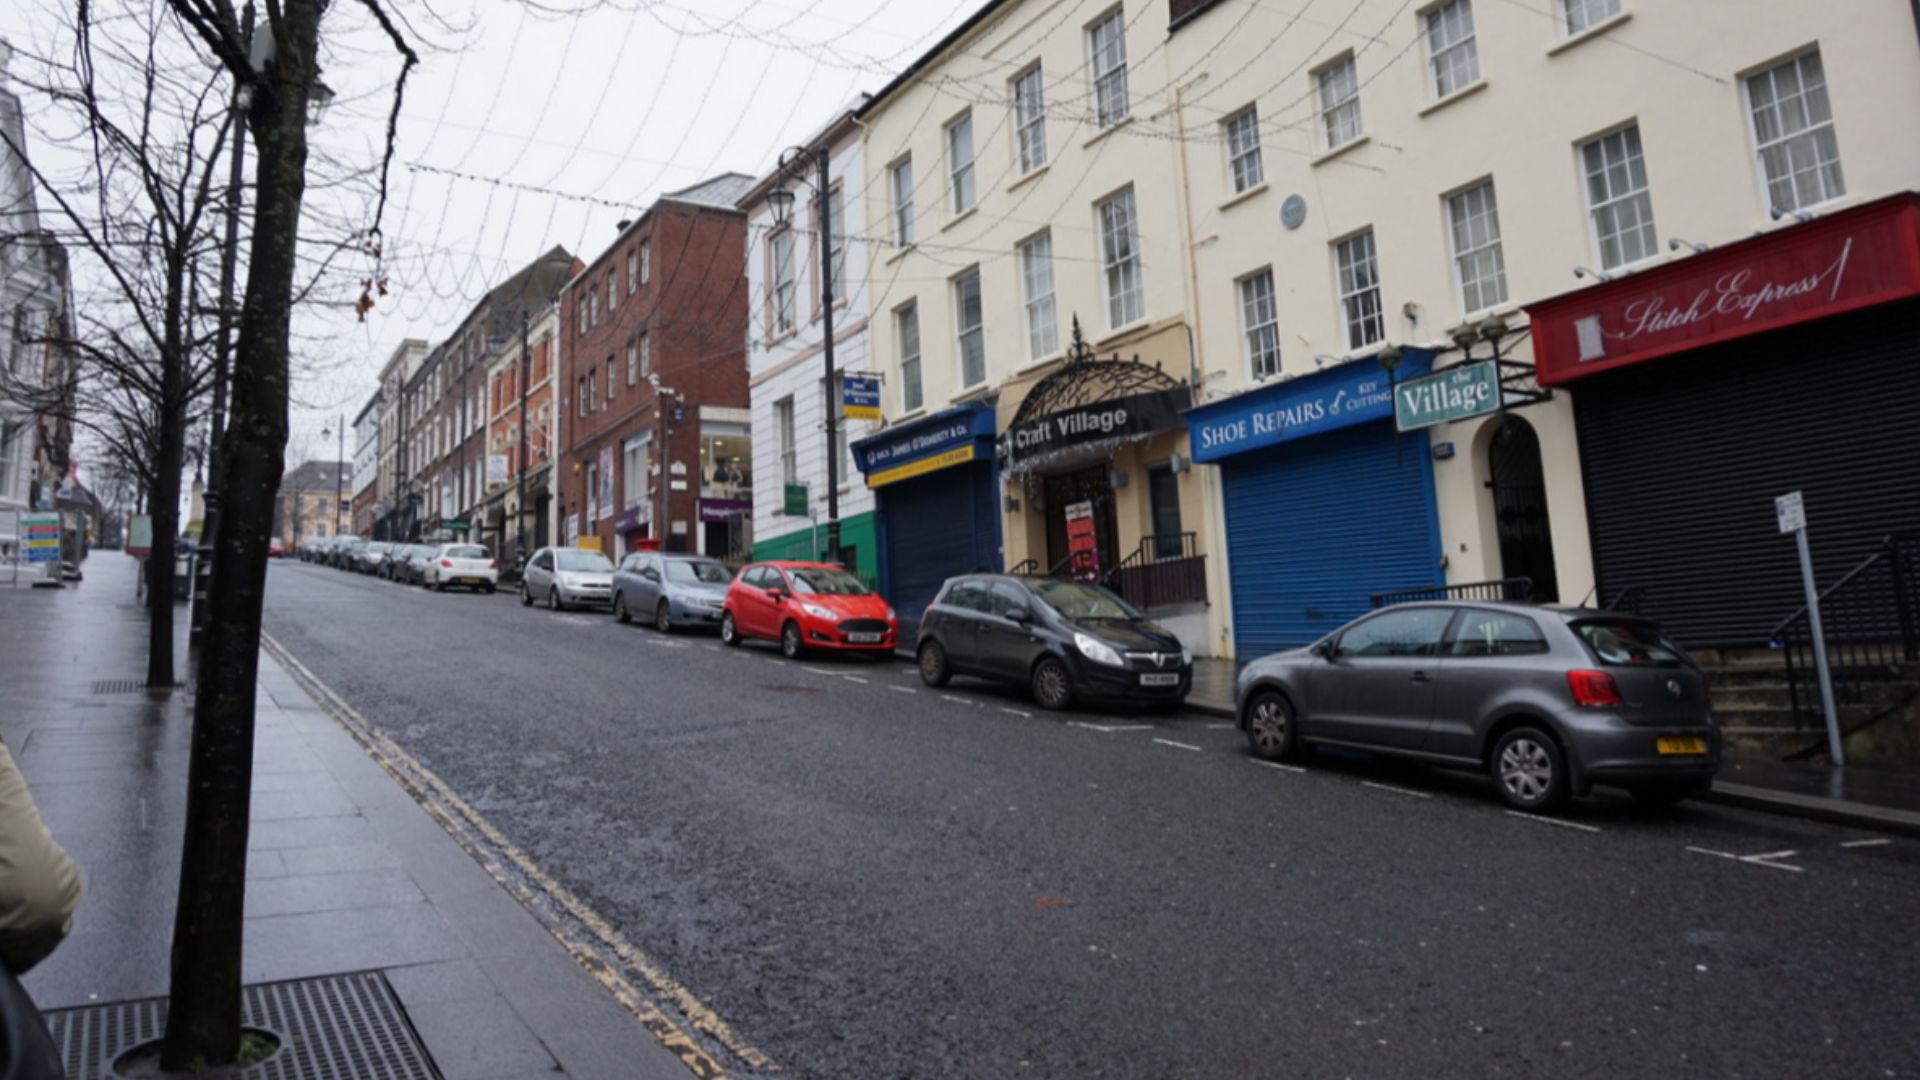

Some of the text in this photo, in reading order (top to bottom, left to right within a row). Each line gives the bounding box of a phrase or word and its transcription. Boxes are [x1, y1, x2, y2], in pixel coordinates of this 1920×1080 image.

[1619, 269, 1819, 338] Stitch Express
[1346, 391, 1392, 411] CUTTING
[1358, 382, 1378, 395] KEY
[1403, 381, 1489, 416] Village
[1016, 408, 1127, 448] Craft Village
[1202, 400, 1325, 448] SHOE REPAIRS
